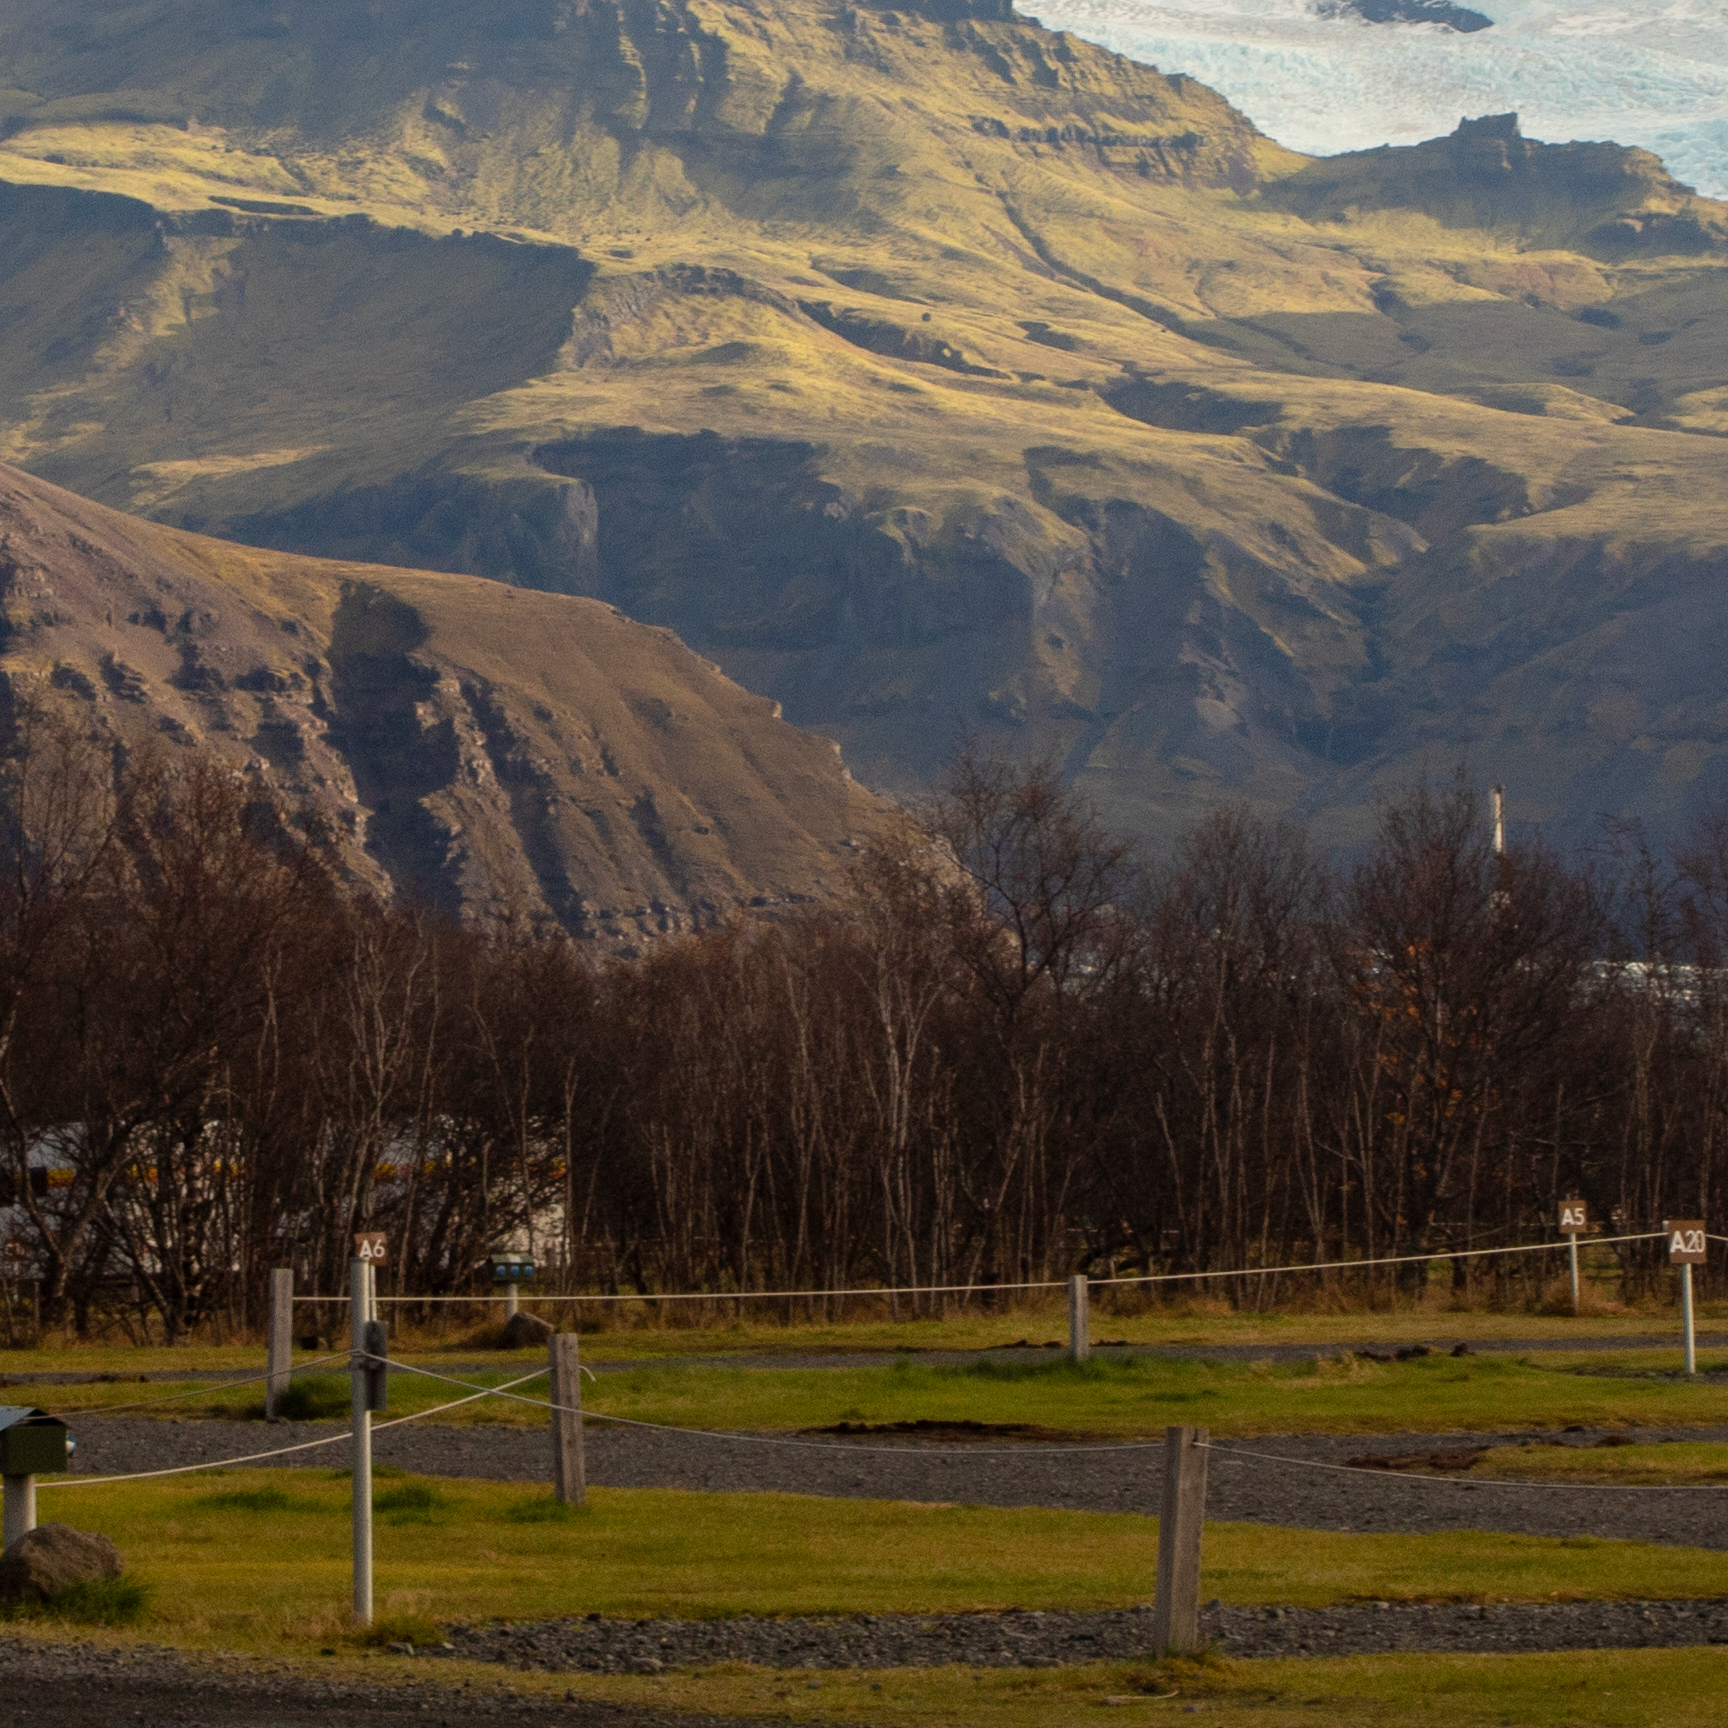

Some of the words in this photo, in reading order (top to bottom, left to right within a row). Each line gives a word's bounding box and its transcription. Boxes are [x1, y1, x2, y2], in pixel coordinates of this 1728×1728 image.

[1561, 1207, 1585, 1225] A5
[359, 1239, 385, 1258] A6
[1670, 1230, 1706, 1253] A20
